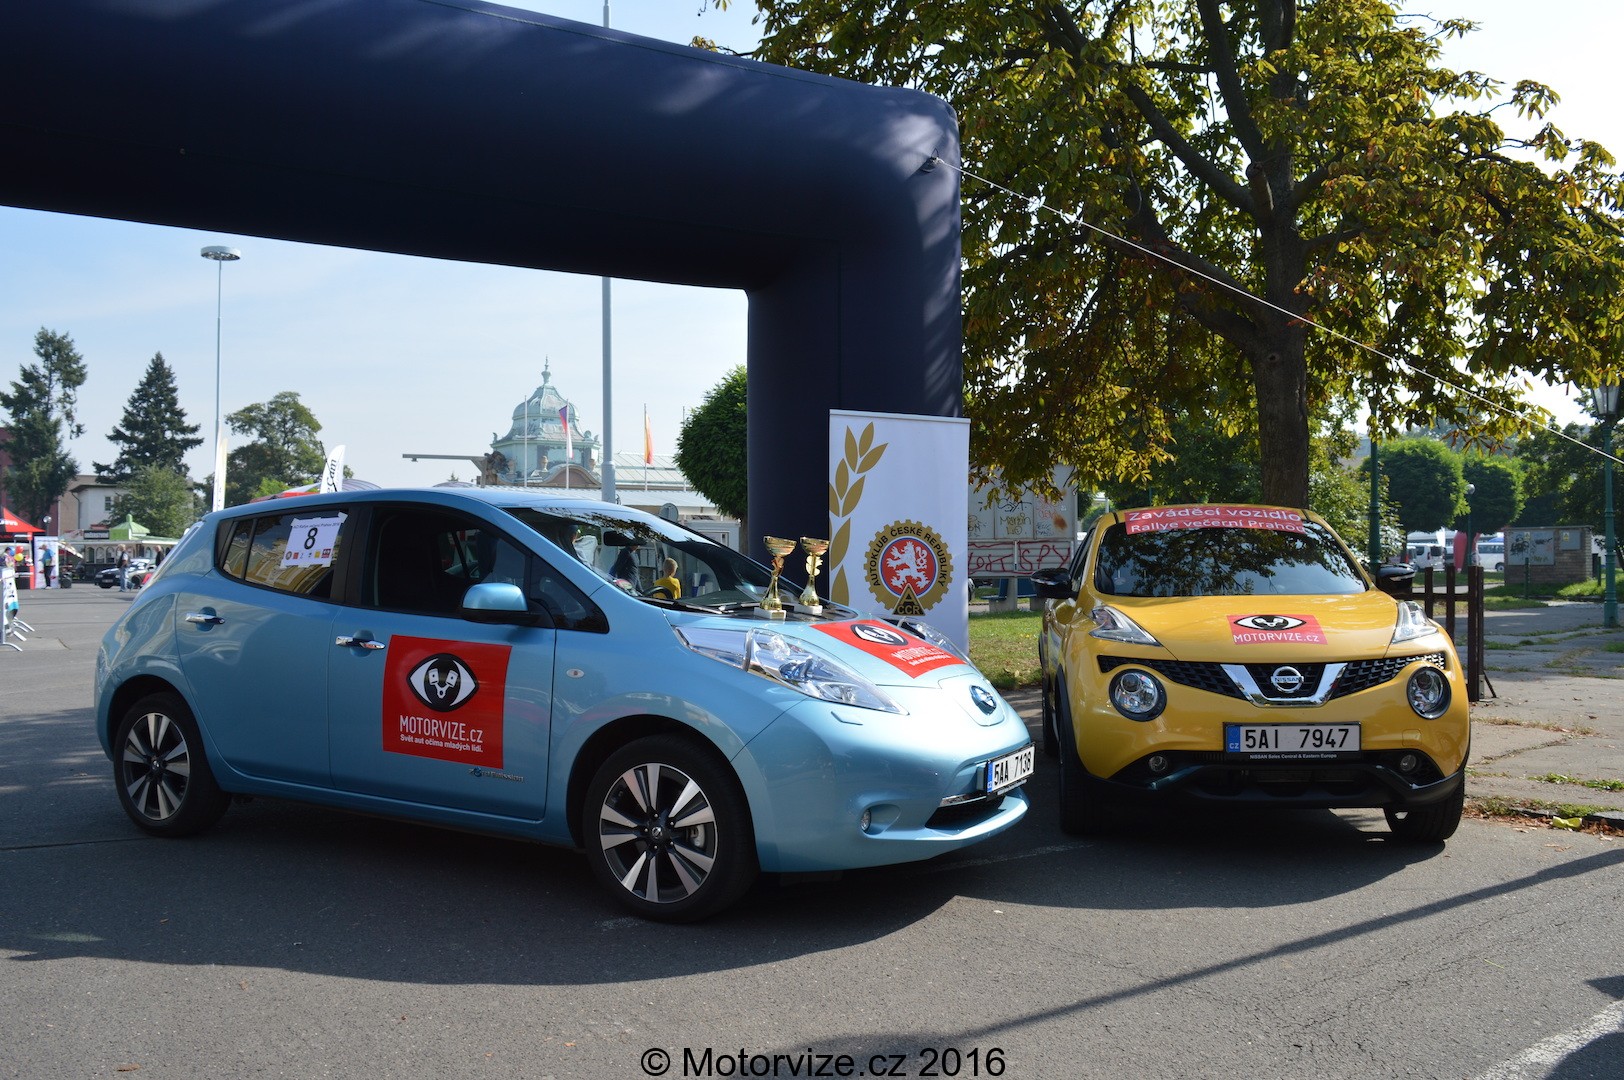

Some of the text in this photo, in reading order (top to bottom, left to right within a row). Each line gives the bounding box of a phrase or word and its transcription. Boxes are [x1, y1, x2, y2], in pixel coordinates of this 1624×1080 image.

[1129, 508, 1302, 521] Zaváděcí vozidlo
[1131, 519, 1306, 533] Rallye večerní Prahou
[303, 527, 318, 550] 8
[869, 526, 948, 587] AUTOKLUB ČESKÉ REPUBLIKY
[400, 734, 414, 743] Svět
[414, 737, 424, 745] aut
[425, 738, 443, 748] očima
[444, 741, 471, 751] mladých
[1229, 728, 1350, 750] CZ 5AI 7947
[994, 760, 1009, 786] 5AA
[1014, 751, 1032, 778] 7138
